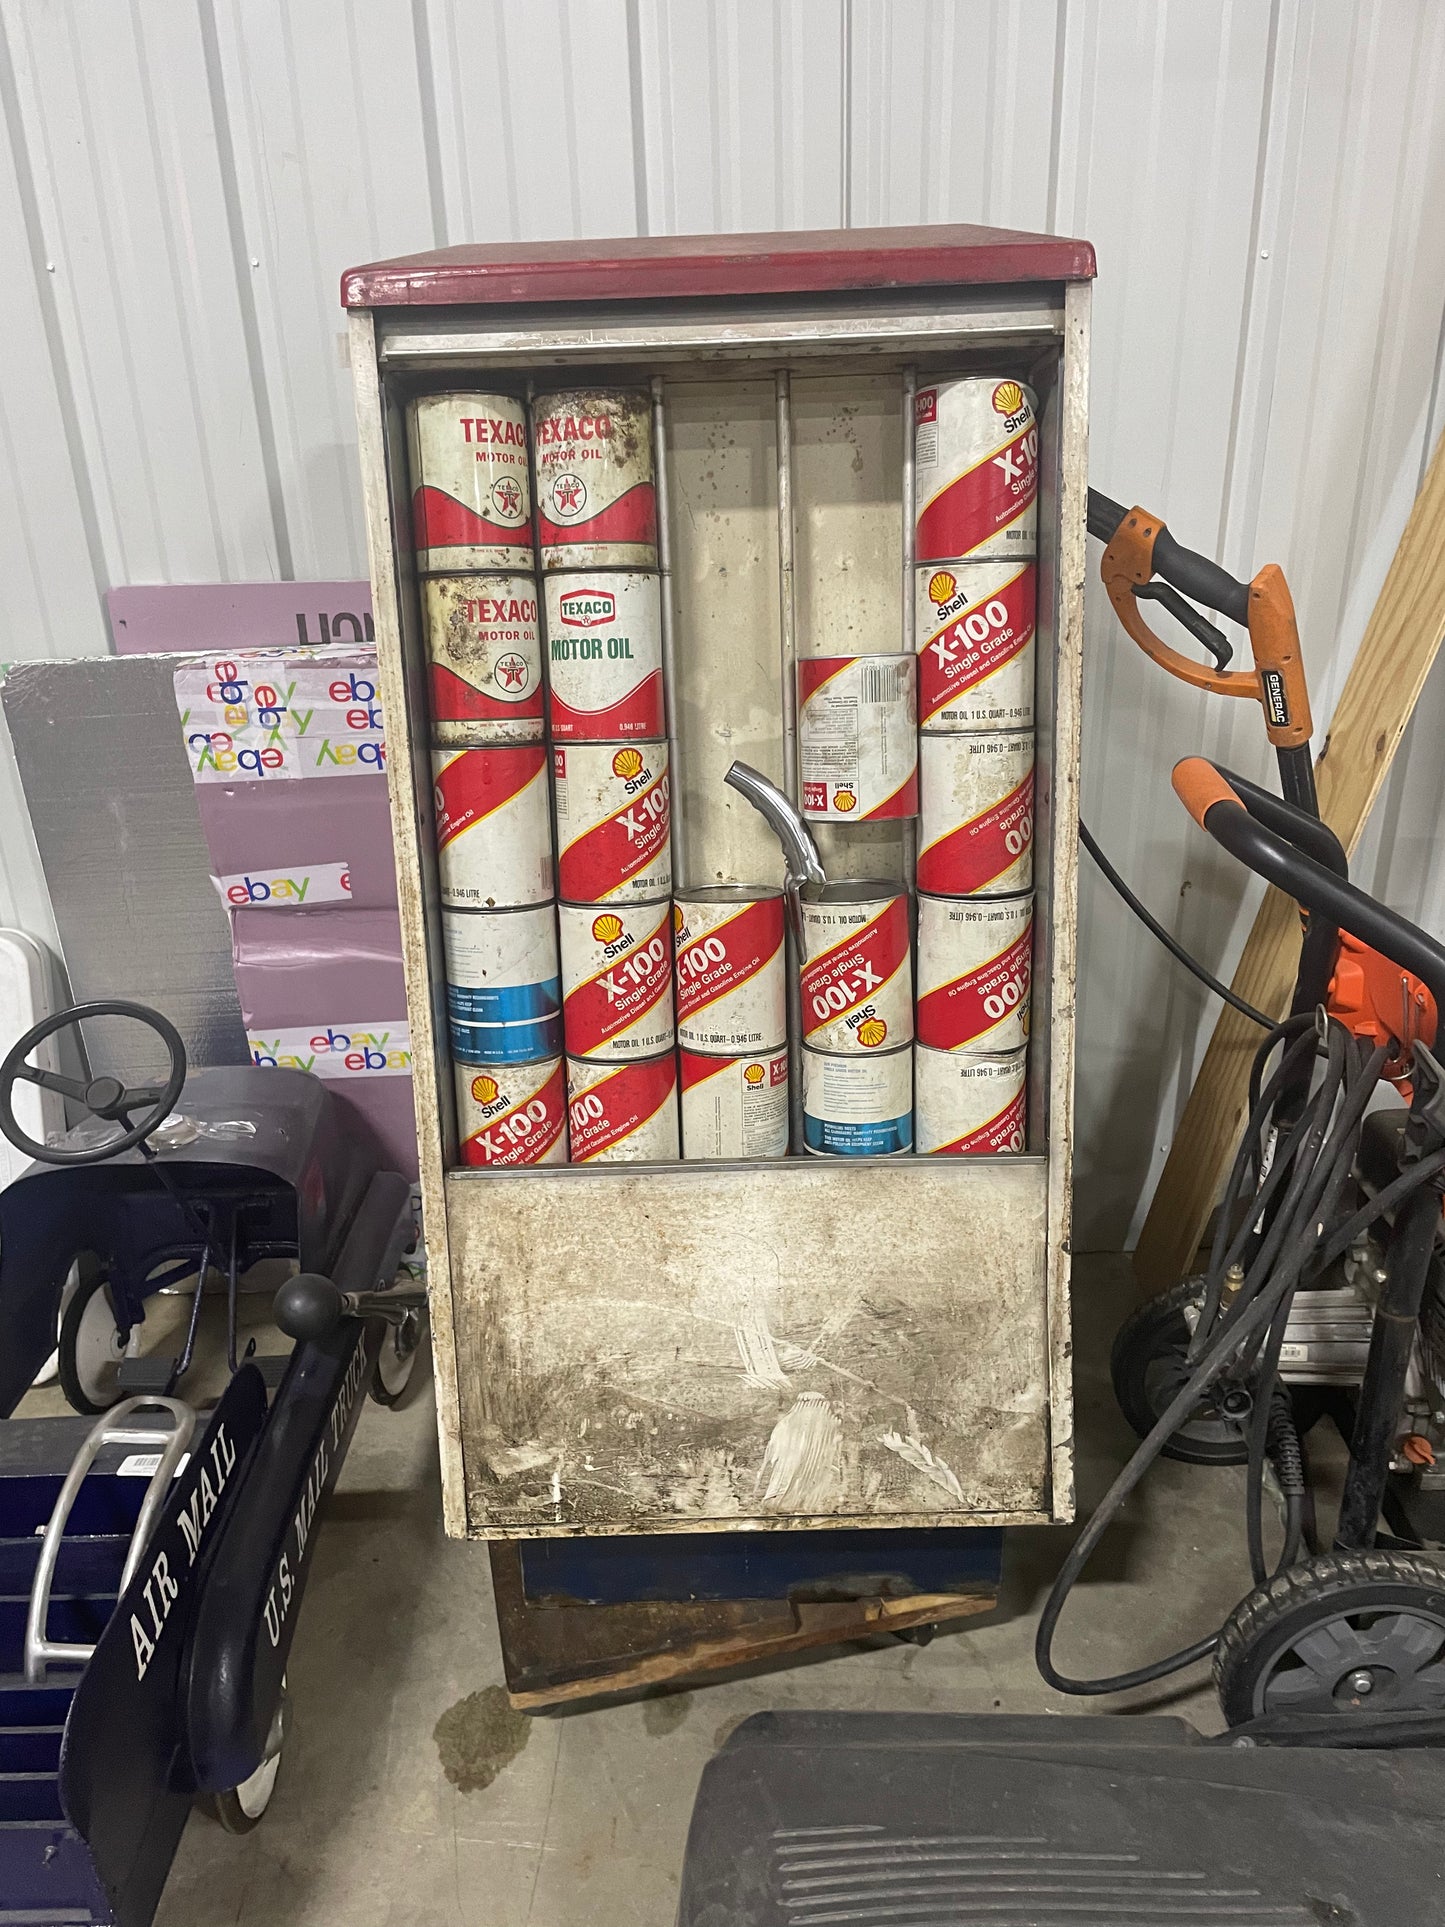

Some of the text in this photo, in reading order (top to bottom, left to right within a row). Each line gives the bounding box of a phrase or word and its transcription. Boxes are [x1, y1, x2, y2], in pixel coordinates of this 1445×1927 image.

[536, 415, 612, 447] TEXACO
[1003, 405, 1031, 434] Shell
[460, 418, 528, 448] TEXAC
[476, 452, 515, 464] MOTOR
[542, 449, 603, 464] MOTOR OIL
[992, 427, 1038, 486] X-10
[995, 498, 1024, 523] Automotive
[464, 599, 537, 623] TEXACO
[562, 600, 612, 615] TEXACO
[937, 592, 969, 621] Shell
[478, 631, 536, 641] MOTOR OIL
[929, 600, 1009, 671] X-100
[551, 638, 634, 661] MOTOR OIL
[944, 627, 1014, 679] Single Grade
[931, 679, 961, 705] Automotive
[960, 668, 980, 685] Diesel
[979, 659, 991, 672] and
[990, 644, 1014, 663] Gasoline
[329, 673, 381, 703] eb
[1270, 674, 1285, 723] GENERAC
[346, 708, 384, 729] eb
[940, 711, 958, 720] MOTOR
[959, 711, 968, 720] OIL
[971, 710, 975, 719] 1
[976, 710, 988, 720] U.S.
[197, 744, 284, 776] ebay
[969, 745, 986, 754] LITRE
[624, 768, 653, 795] Shell
[450, 809, 474, 830] Engine Oil
[615, 775, 670, 842] X-100
[1000, 805, 1026, 831] Grade
[969, 827, 979, 836] Oil
[979, 814, 1000, 830] Engine
[634, 822, 661, 849] Single
[620, 850, 649, 874] Automotive
[227, 877, 310, 905] ebay
[465, 888, 480, 898] LITRE
[632, 878, 648, 888] MOTOR
[822, 914, 867, 924] MOTOR OIL 1 U.S.
[949, 912, 964, 921] LITRE
[604, 932, 635, 959] Shell
[676, 927, 691, 947] Shell
[848, 928, 878, 952] Automotive
[824, 958, 834, 969] and
[836, 947, 849, 961] Diesel
[1001, 956, 1011, 966] and
[595, 937, 665, 1003] X-100
[680, 961, 733, 1000] Single Grade
[701, 989, 710, 1000] and
[710, 976, 734, 993] Gasoline
[733, 963, 753, 979] Engine
[752, 956, 761, 966] Oil
[808, 953, 865, 993] Single Grade
[977, 965, 1001, 981] Gasoline
[614, 985, 647, 1011] Single
[646, 960, 668, 986] Grade
[812, 960, 883, 1020] X-100
[948, 989, 957, 997] Oil
[956, 979, 977, 992] Engine
[977, 972, 1010, 996] Grade
[601, 1012, 631, 1034] Automotive
[630, 999, 646, 1015] Diesel
[646, 991, 656, 1002] and
[845, 1004, 876, 1030] Shell
[309, 1029, 390, 1054] ebay
[612, 1036, 656, 1048] MOTOR OIL 1 U.S.
[700, 1033, 709, 1042] U.S.
[748, 1032, 762, 1042] LITRE
[252, 1051, 316, 1072] bay
[960, 1068, 976, 1077] LITRE
[746, 1083, 764, 1091] Shell
[481, 1095, 511, 1119] Shell
[475, 1099, 547, 1161] X-100
[583, 1118, 610, 1140] Grade
[583, 1115, 638, 1152] and Gasoline Engine Oil
[989, 1115, 1010, 1133] Gasoline
[990, 1120, 1016, 1147] Grade
[492, 1143, 525, 1166] Single
[524, 1120, 553, 1147] Grade
[960, 1143, 971, 1151] Oil
[970, 1132, 990, 1145] Engine
[263, 1326, 368, 1648] U.S. MAIL TRUCK
[129, 1422, 236, 1682] AIR MAIL
